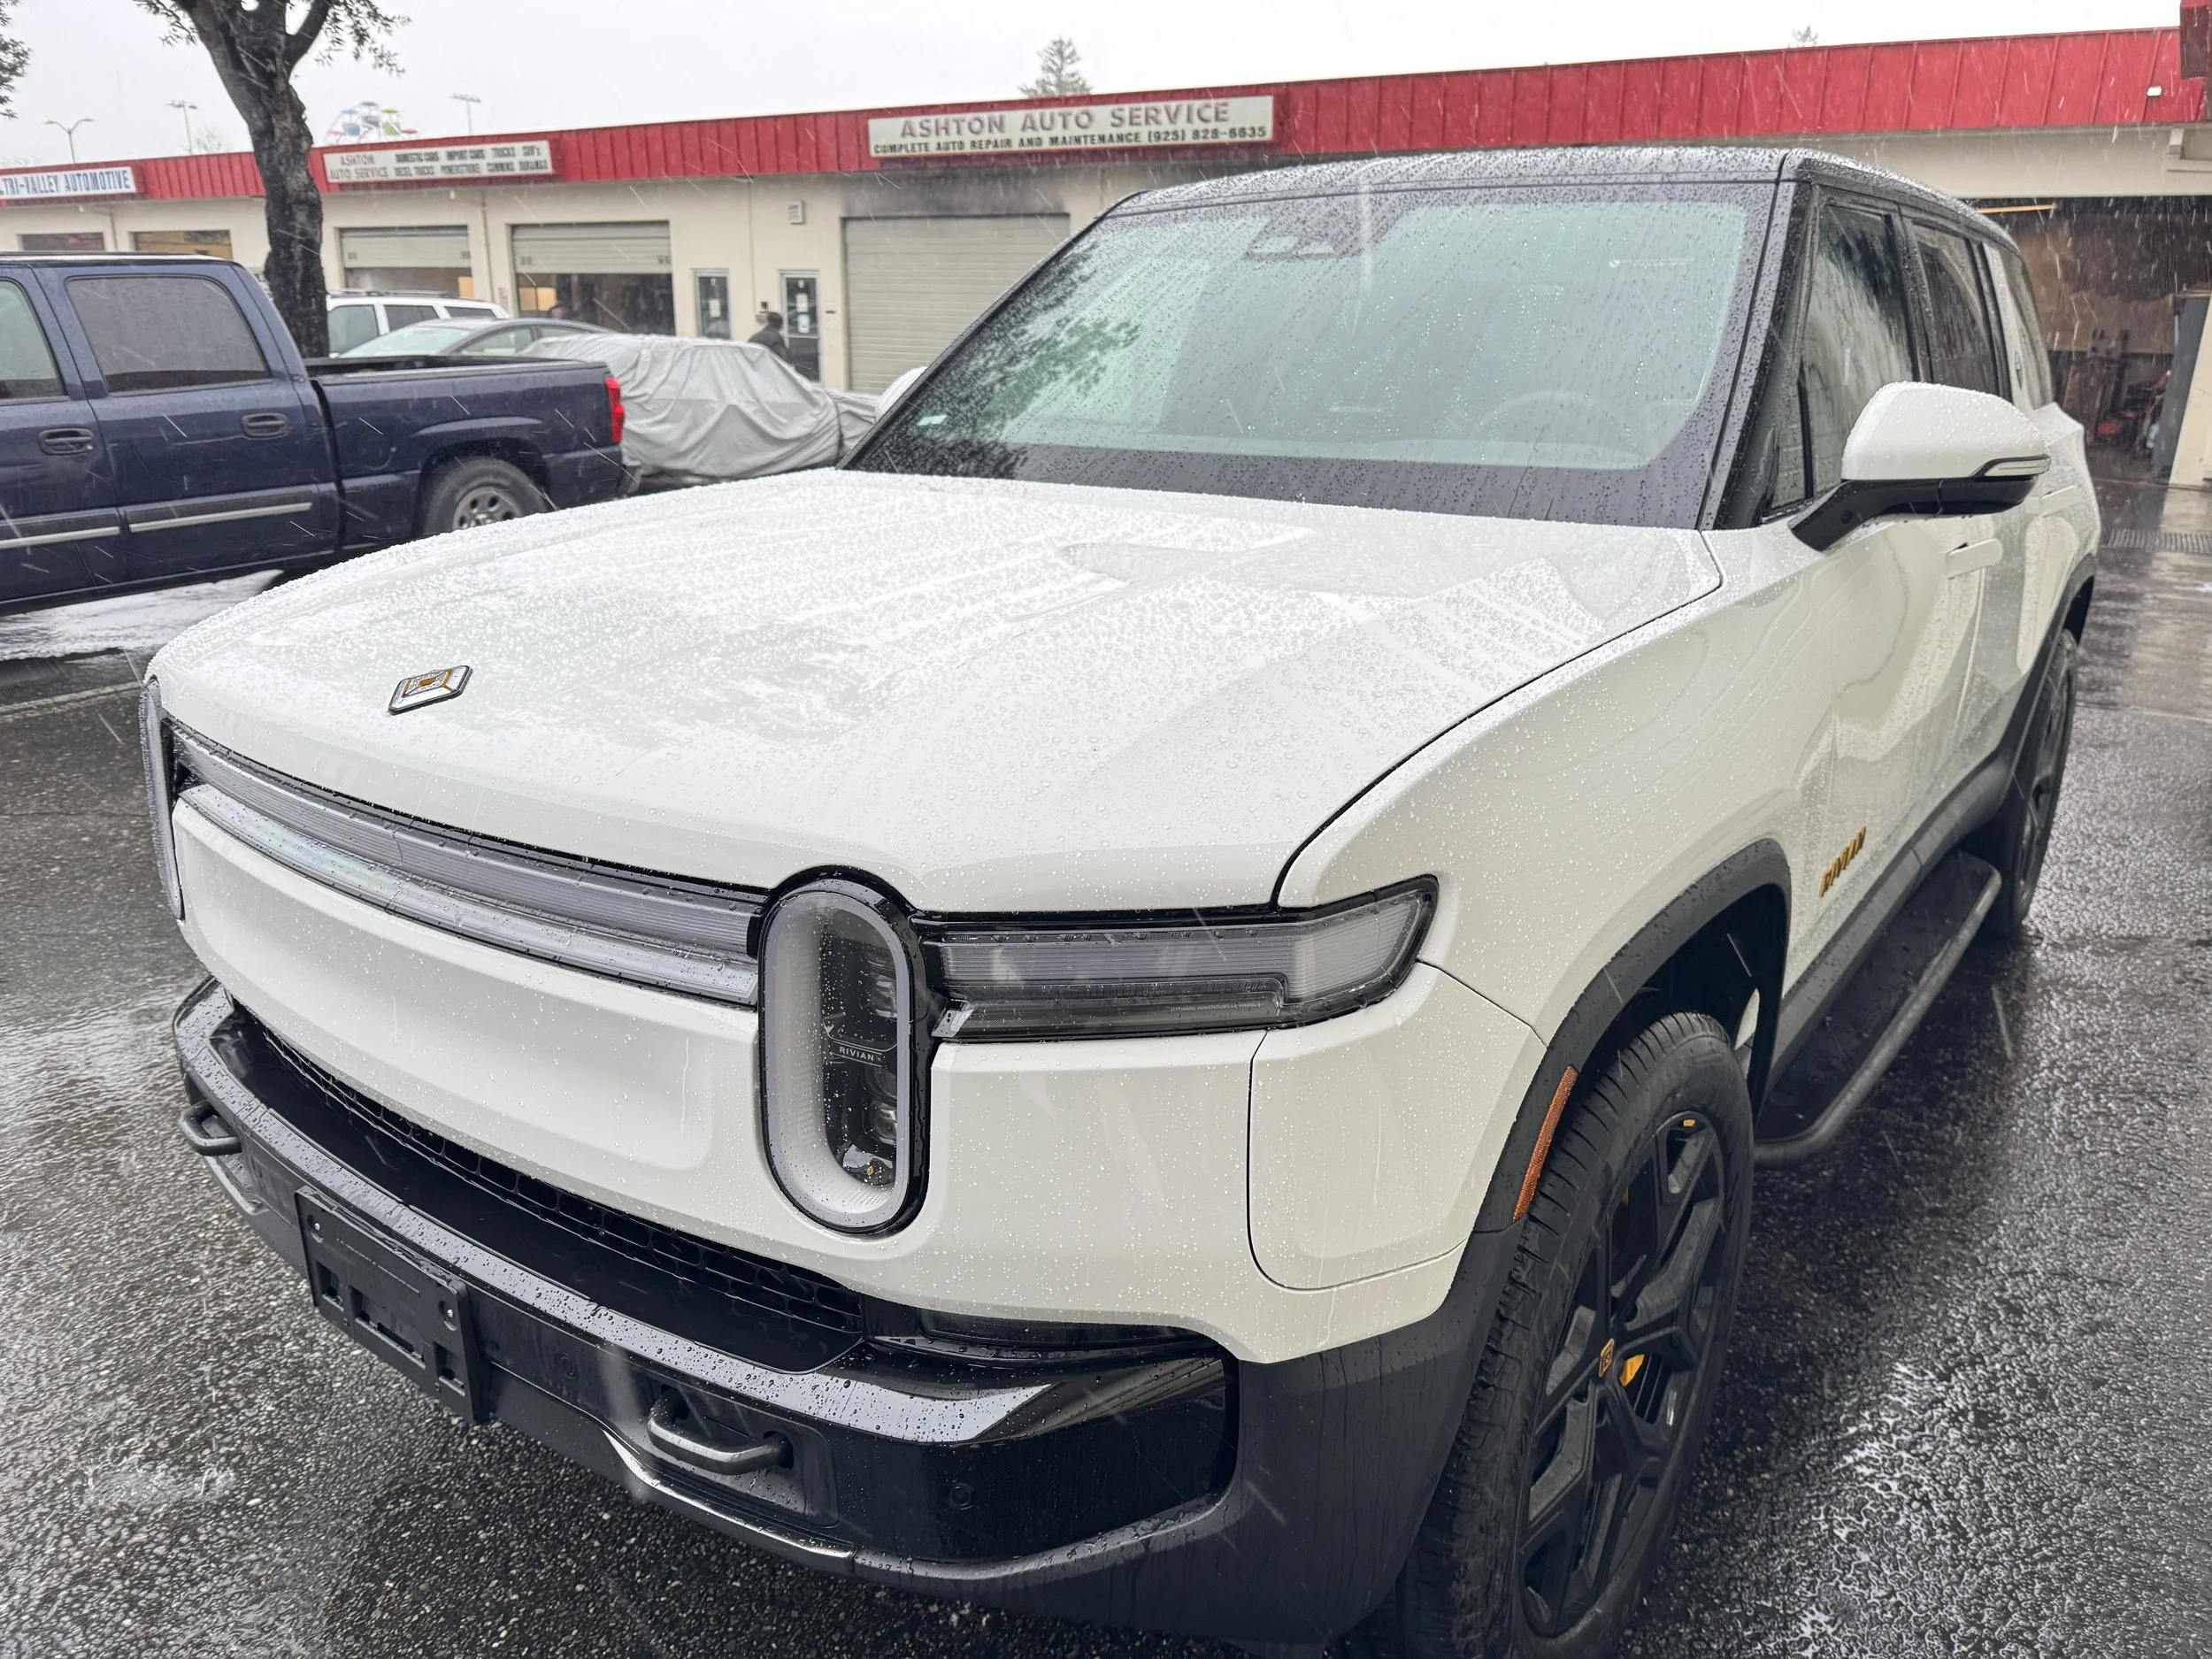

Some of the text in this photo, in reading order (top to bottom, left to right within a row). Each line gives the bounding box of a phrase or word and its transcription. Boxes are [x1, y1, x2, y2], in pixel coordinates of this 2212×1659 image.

[901, 101, 1229, 139] ASHTON AUTO SERVICE
[873, 142, 930, 154] COMPLETE
[935, 140, 965, 152] AUTO
[970, 138, 1012, 150] REPAIR
[1018, 136, 1043, 148] AND
[1048, 133, 1142, 147] MAINTENANCE
[1147, 130, 1187, 143] (925)
[340, 154, 375, 166] ASHTON
[354, 165, 388, 179] SERVICE
[3, 170, 130, 194] TRI-VALLEY AUTOMOTIVE
[840, 1047, 874, 1061] RIVIAN
